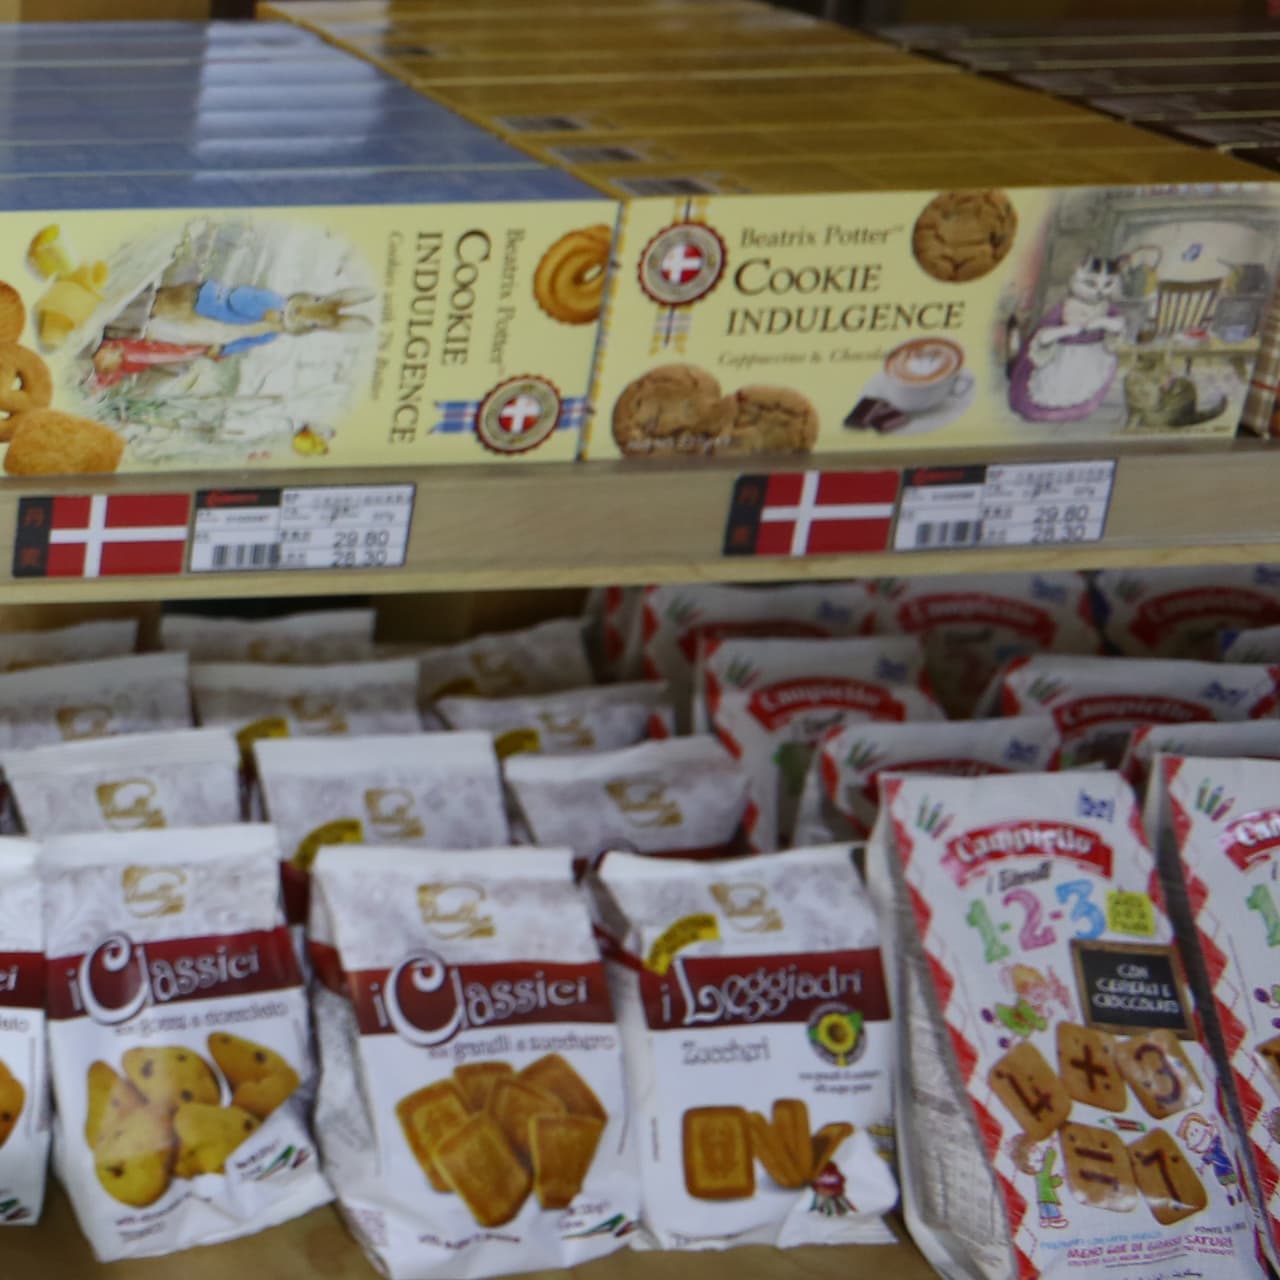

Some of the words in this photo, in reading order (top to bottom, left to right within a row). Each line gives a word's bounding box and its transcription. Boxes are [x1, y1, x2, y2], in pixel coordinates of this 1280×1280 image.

[741, 227, 816, 248] Beatrix
[734, 257, 882, 296] COOKIE
[441, 229, 491, 366] COOKIE
[389, 231, 443, 444] INDULGENCE
[726, 301, 965, 337] INDULGENCE
